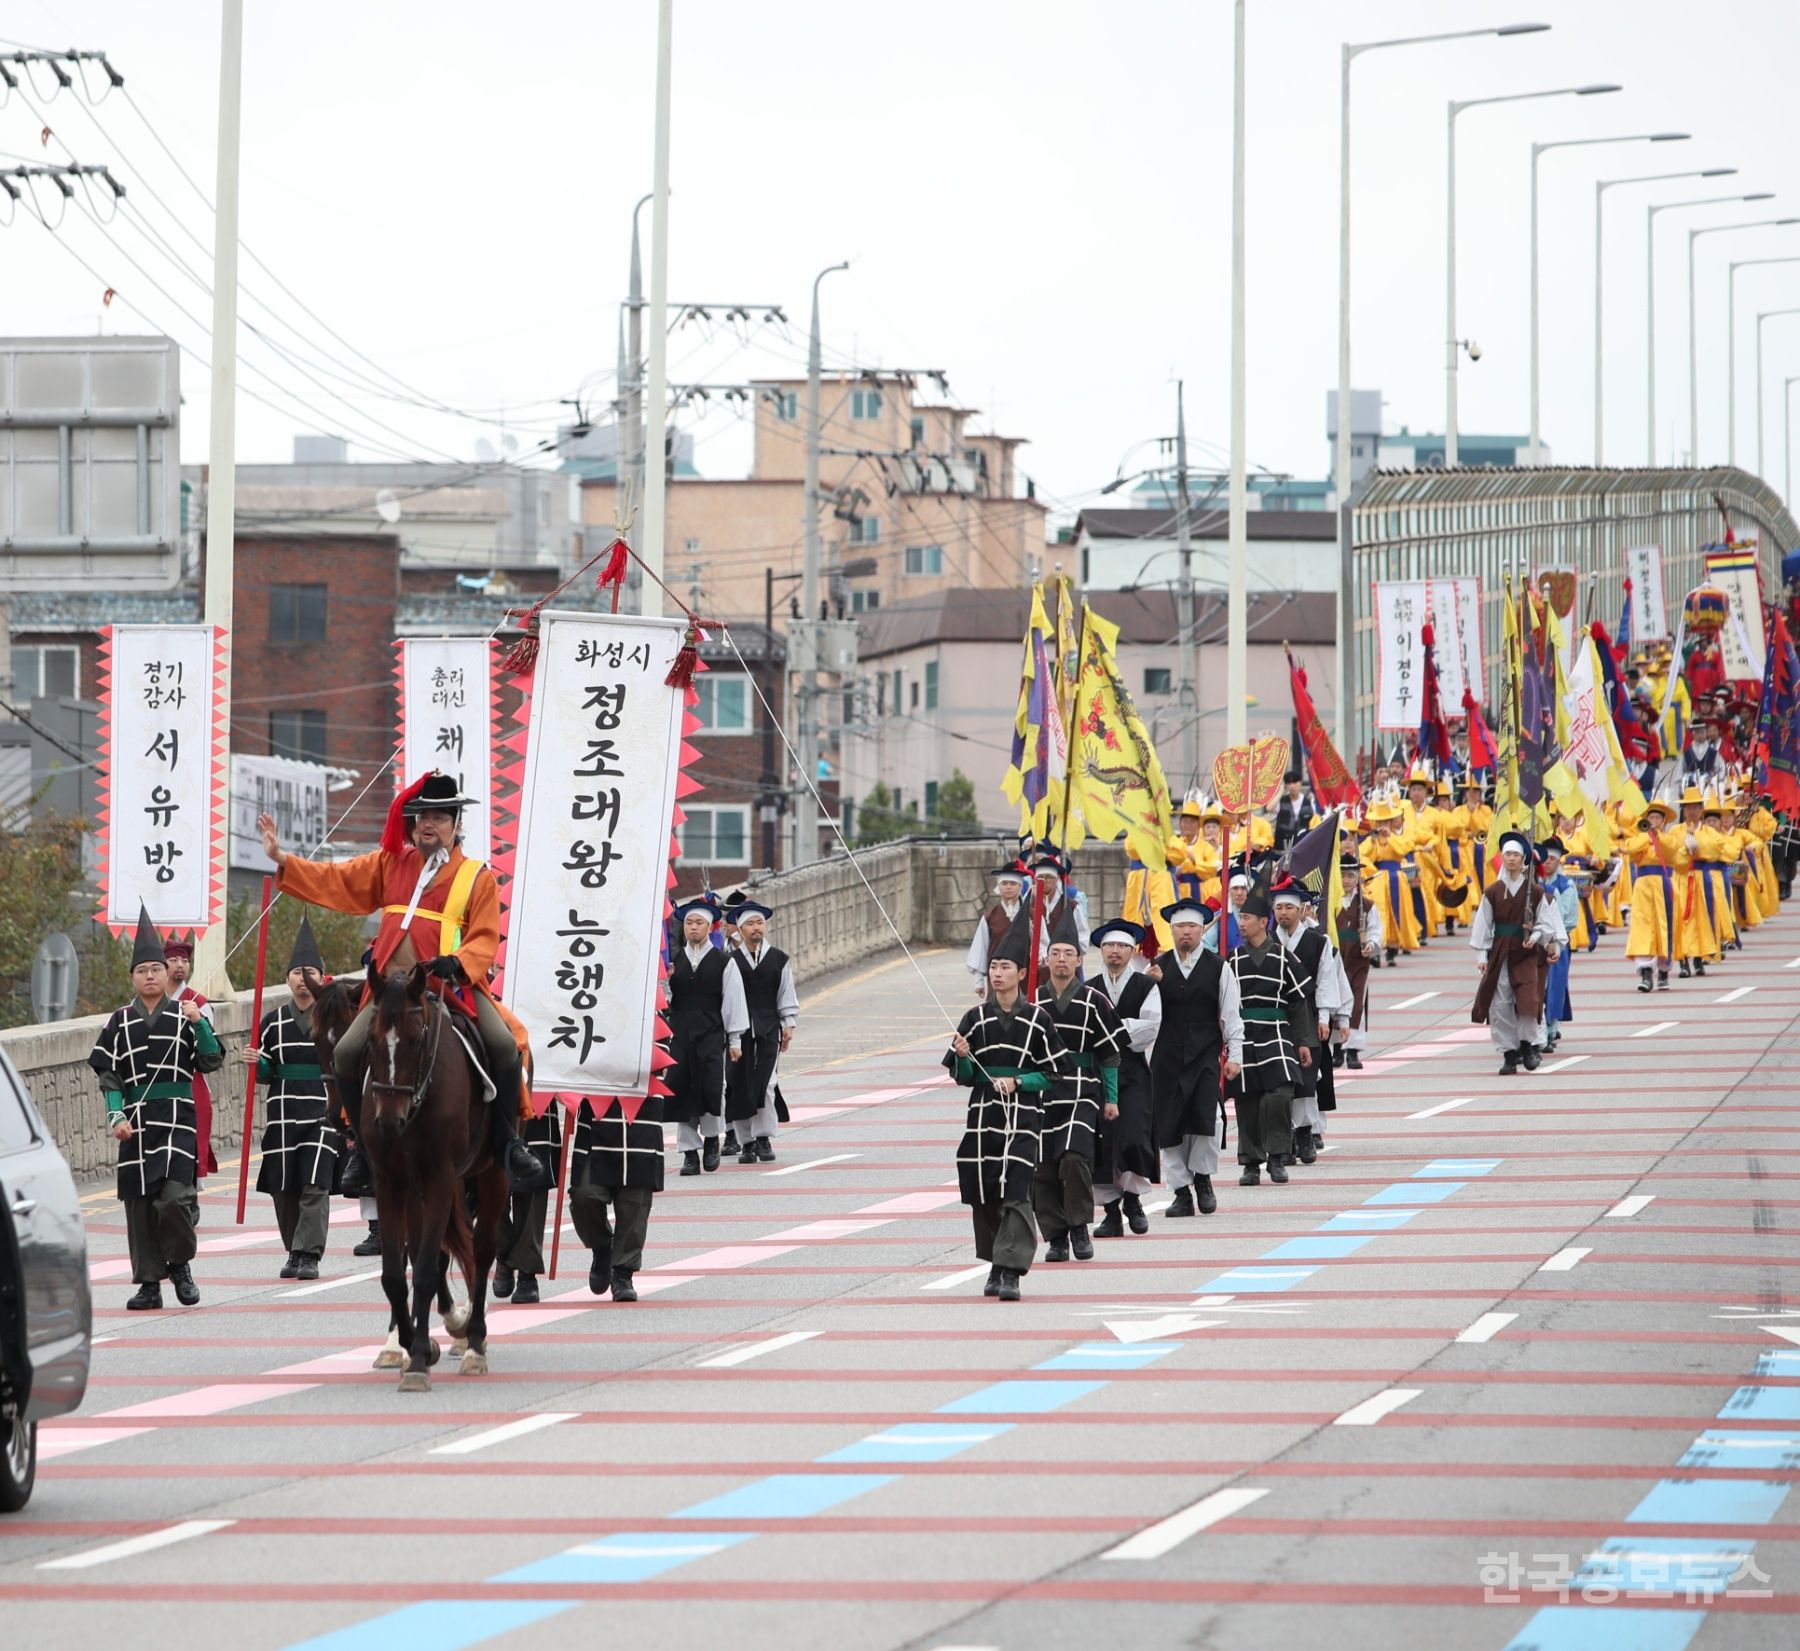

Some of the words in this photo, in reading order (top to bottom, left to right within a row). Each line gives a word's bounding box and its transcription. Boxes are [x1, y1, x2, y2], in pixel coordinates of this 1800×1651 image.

[574, 639, 651, 672] 화성시
[143, 660, 183, 685] 경기
[431, 666, 464, 688] 총리
[143, 686, 187, 710] 감사
[432, 689, 467, 709] 대신
[561, 683, 627, 888] 정조대왕
[143, 728, 184, 883] 서유방
[547, 908, 611, 1065] 능행차
